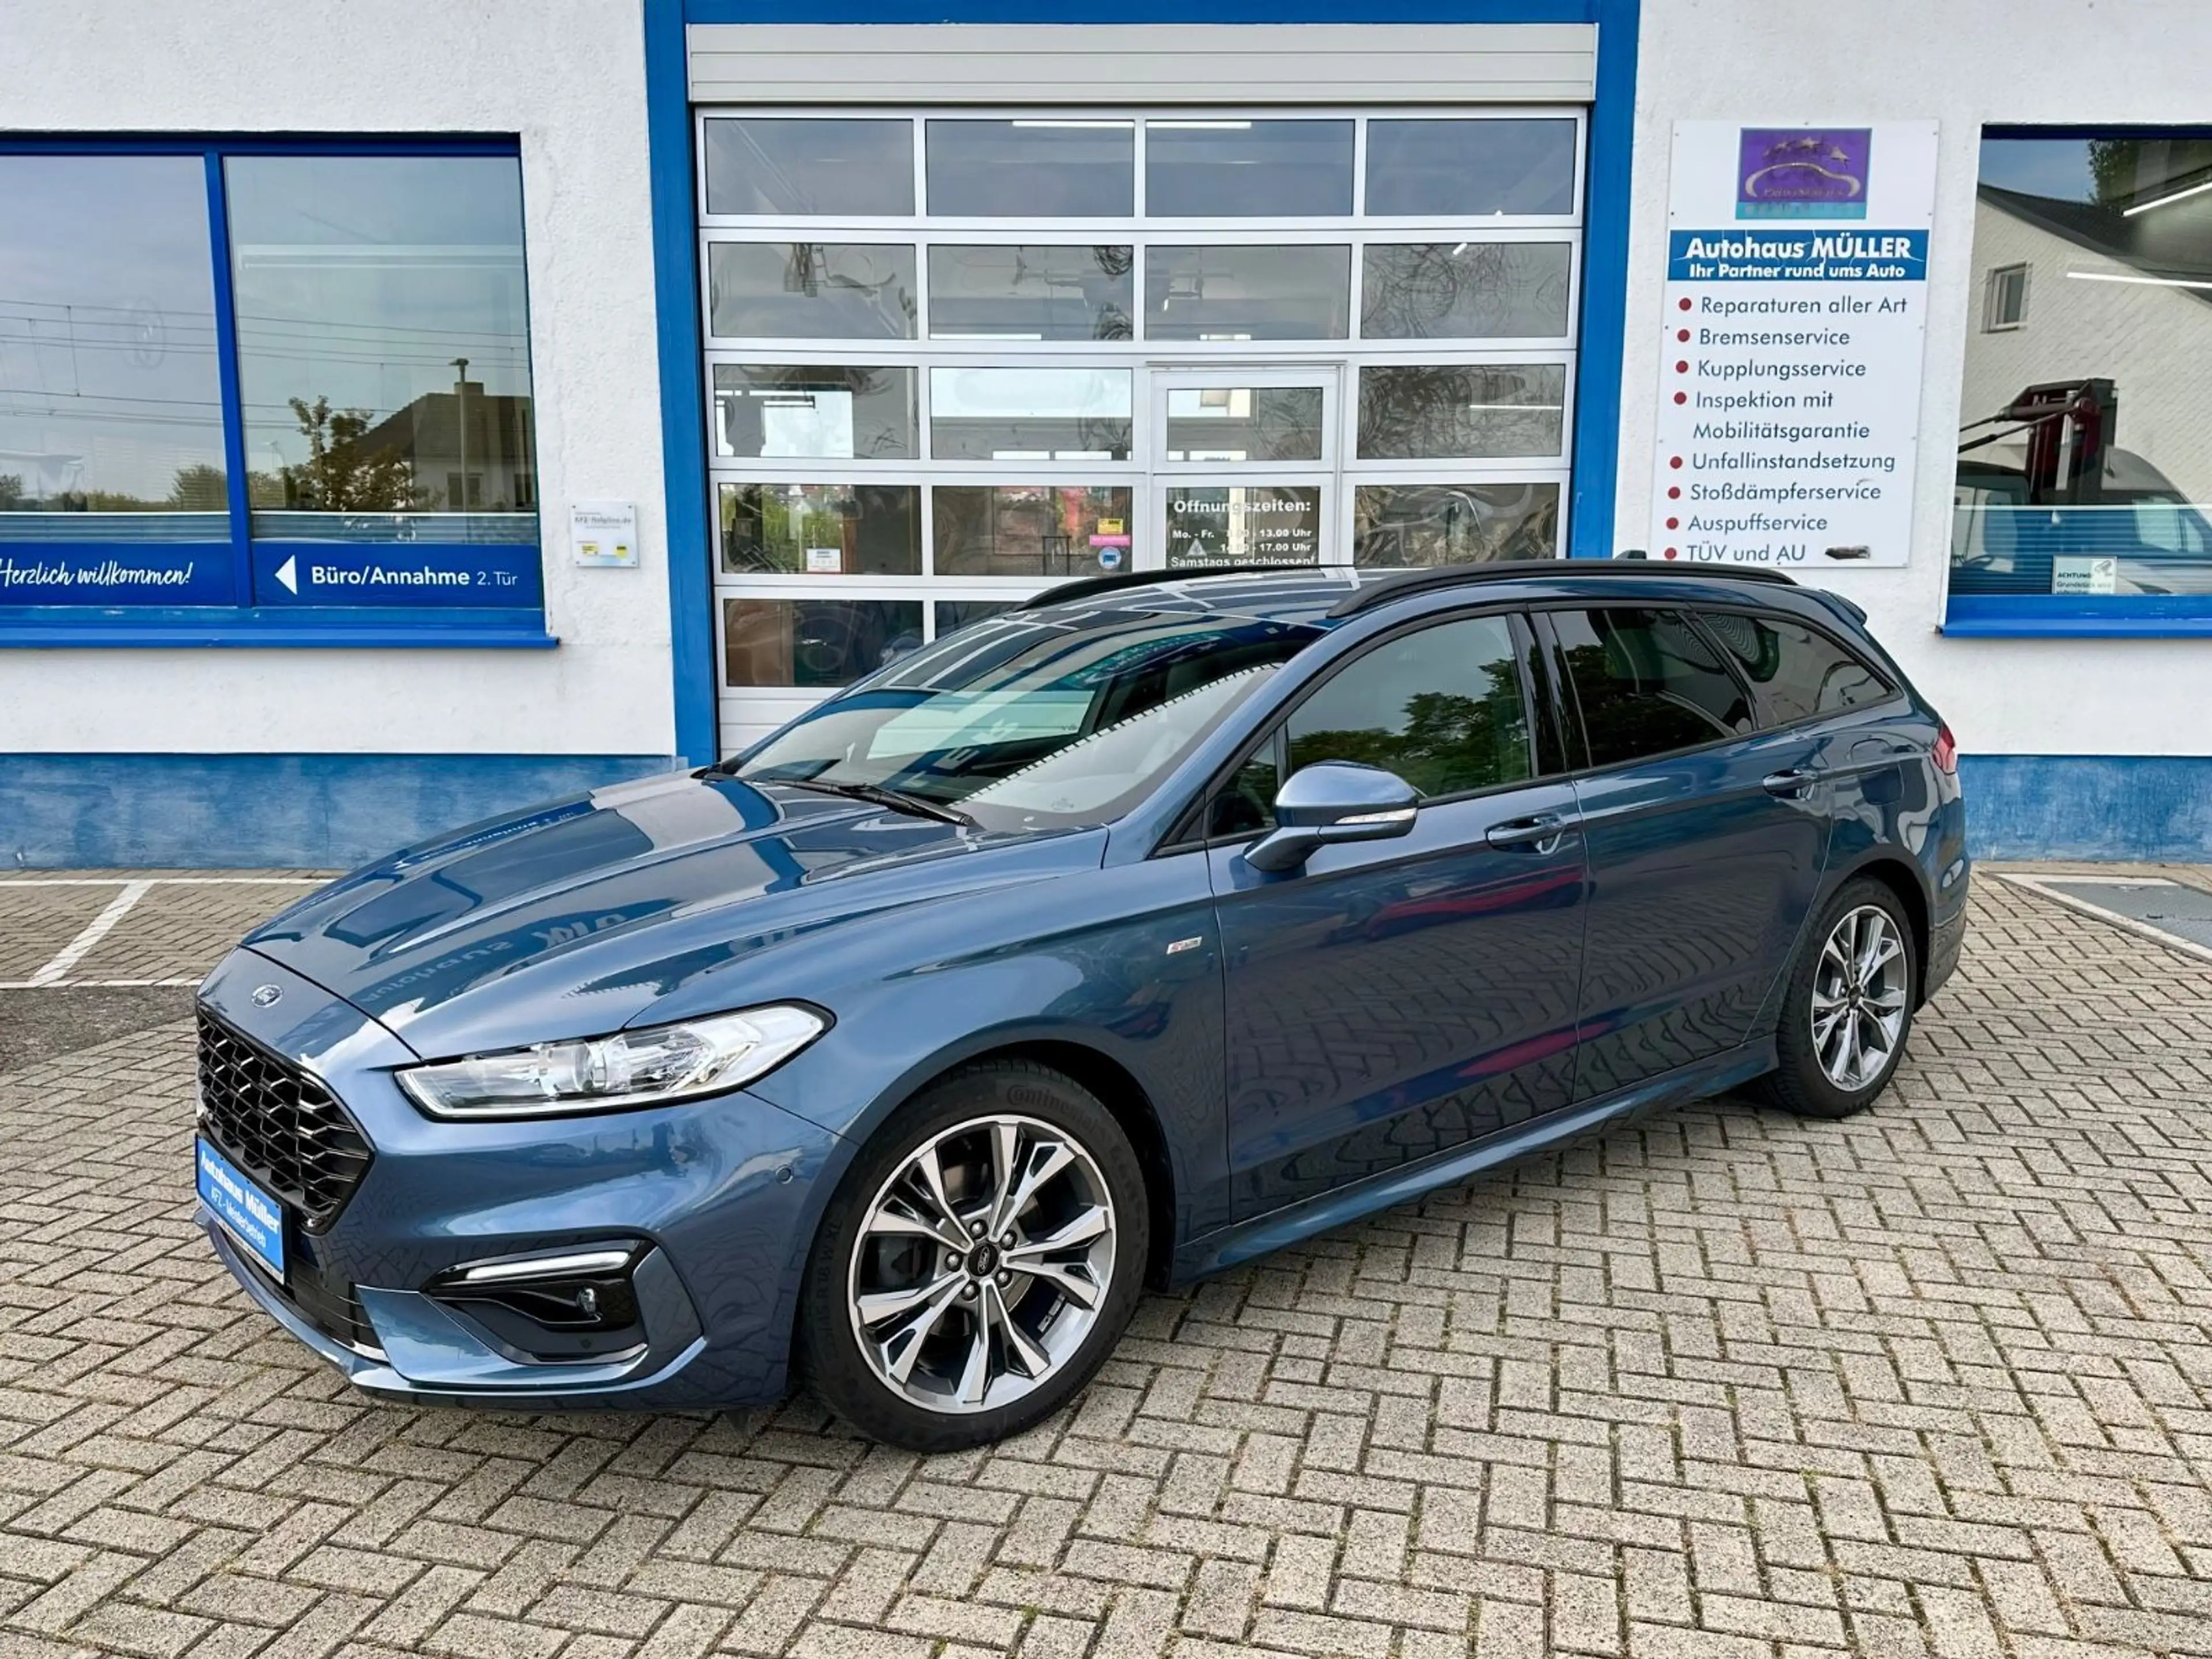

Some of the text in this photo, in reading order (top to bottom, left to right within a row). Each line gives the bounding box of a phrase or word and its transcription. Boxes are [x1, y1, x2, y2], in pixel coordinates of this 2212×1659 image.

[1685, 233, 1911, 259] Autohaus MÜLLER
[1690, 263, 1905, 278] Ihr Partner rund ums Auto
[1702, 295, 1907, 317] Reparaturen aller Art
[1699, 327, 1850, 346] Bremsenservice
[1698, 359, 1866, 381] Kupplungsservice
[1696, 390, 1833, 412] Inspektion mit
[1693, 421, 1870, 442] Mobilitätsgarantie
[1692, 452, 1895, 472] Unfallinstandsetzung
[1691, 482, 1881, 504] Stoßdämpferservice
[1172, 530, 1191, 539] Mo.
[1201, 529, 1215, 539] Fr.
[1259, 529, 1290, 537] 13.00
[1292, 529, 1312, 537] Uhr
[1688, 513, 1827, 535] Auspuffservice
[1259, 543, 1289, 552] 17.00
[1292, 543, 1312, 551] Uhr
[1687, 541, 1805, 562] TÜV und AU
[0, 558, 193, 587] Herzlich willkommen!
[1171, 556, 1231, 568] Samstags
[312, 566, 517, 586] Büro/Annahme 2. Tür
[200, 1150, 280, 1234] Autohaus Müller
